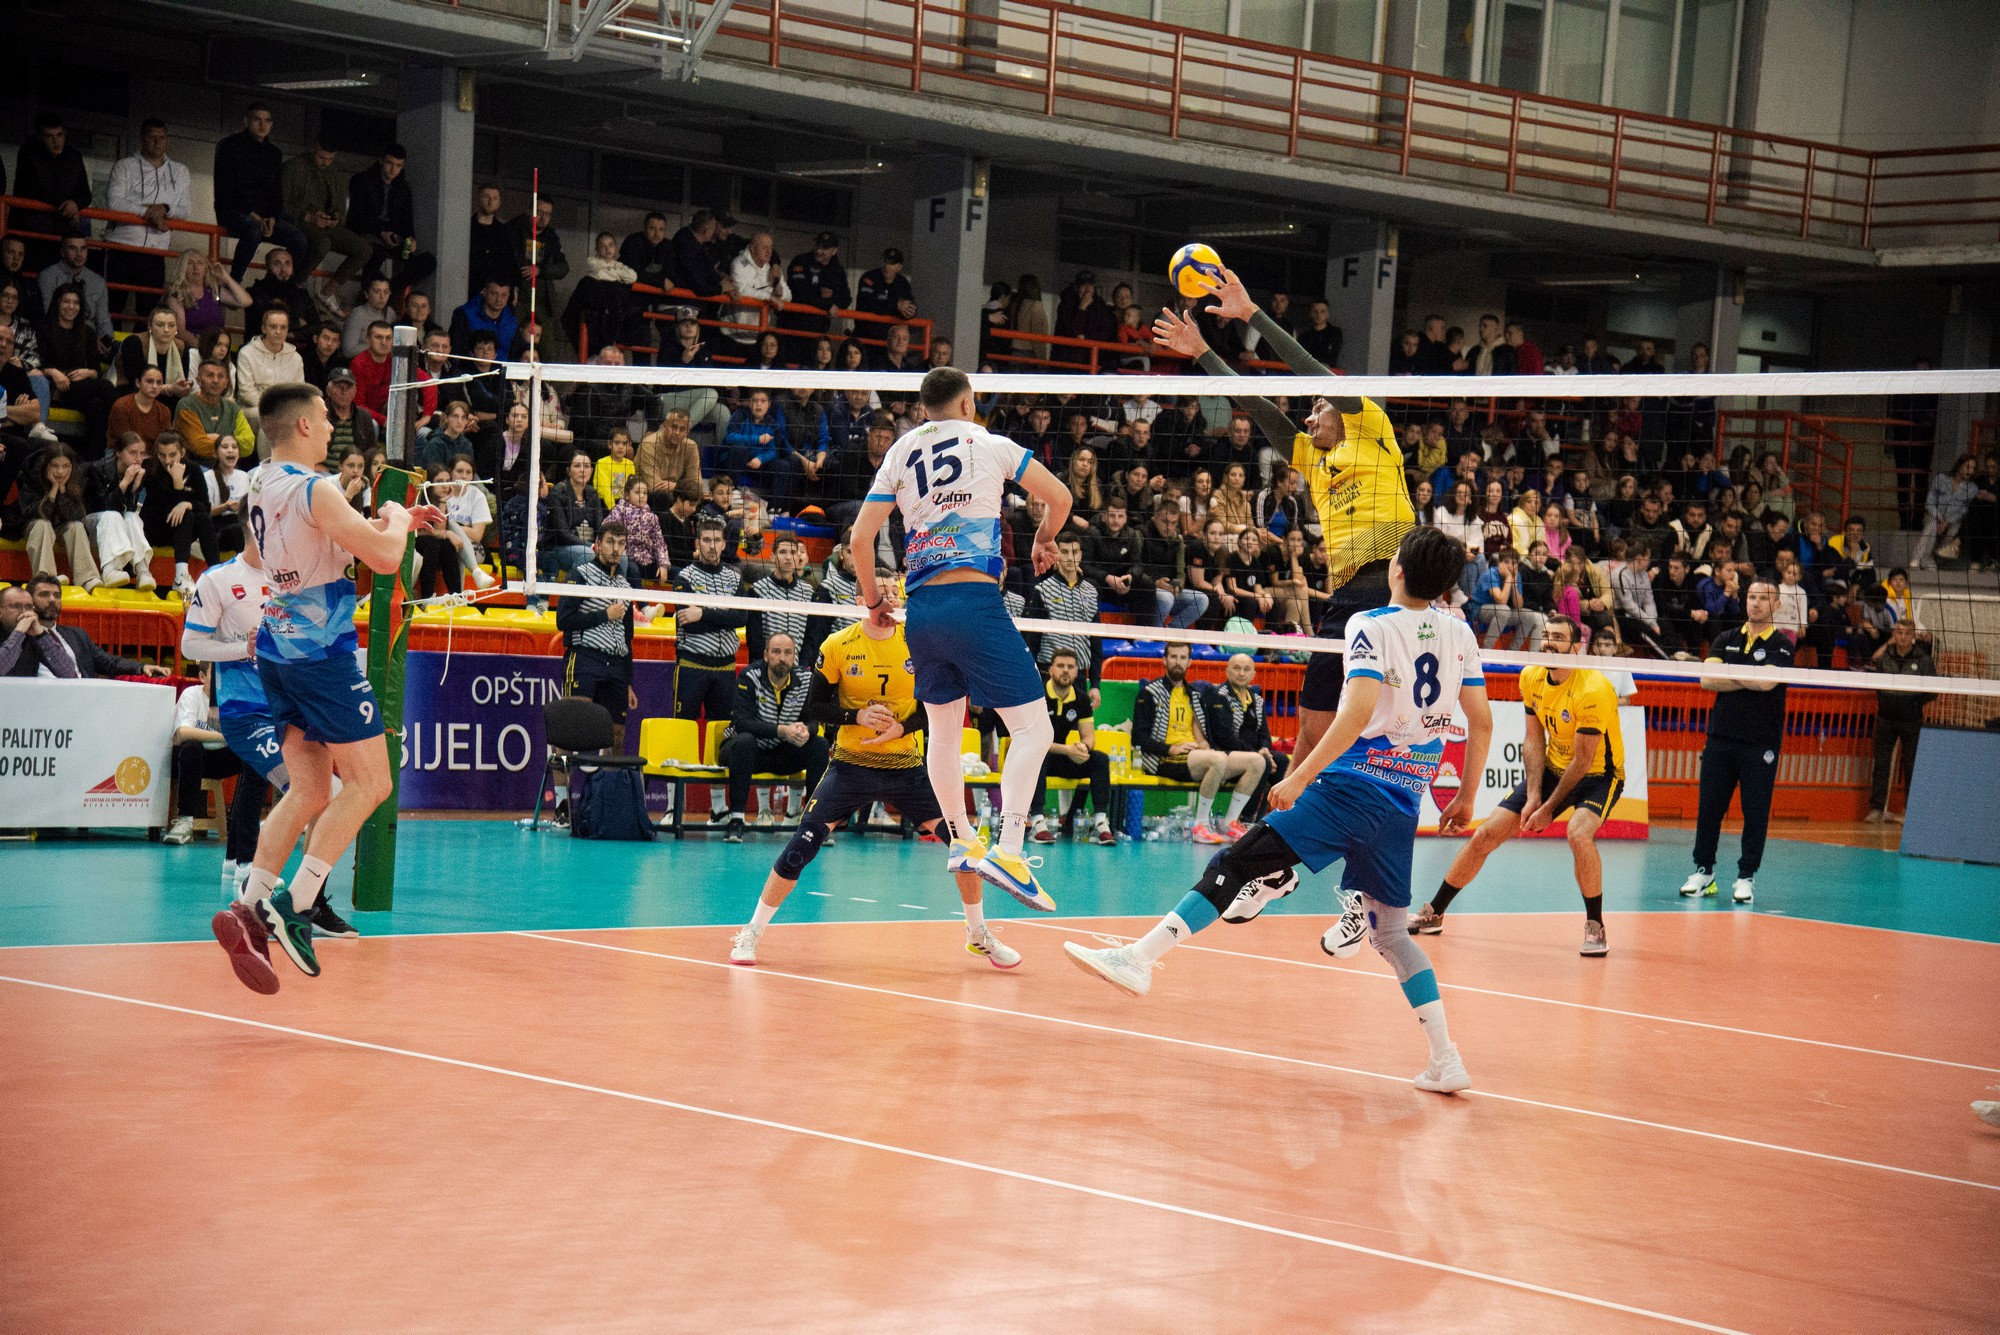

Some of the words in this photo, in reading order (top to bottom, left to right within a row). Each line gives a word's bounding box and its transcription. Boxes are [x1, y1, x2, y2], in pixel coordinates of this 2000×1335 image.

[929, 198, 946, 232] F
[966, 199, 983, 231] F
[1343, 258, 1359, 288] F
[1378, 258, 1392, 289] F
[906, 437, 963, 499] 15
[471, 672, 563, 706] OPŠTIN
[878, 674, 889, 696] 7
[1413, 651, 1441, 708] 8
[359, 701, 374, 725] 9
[1175, 707, 1186, 722] 17
[1, 728, 52, 748] PALITY
[55, 729, 73, 749] OF
[255, 737, 280, 759] 16
[12, 756, 56, 777] POLJE
[1486, 768, 1525, 788] BIJE
[1402, 776, 1427, 794] POL
[808, 799, 817, 812] 7
